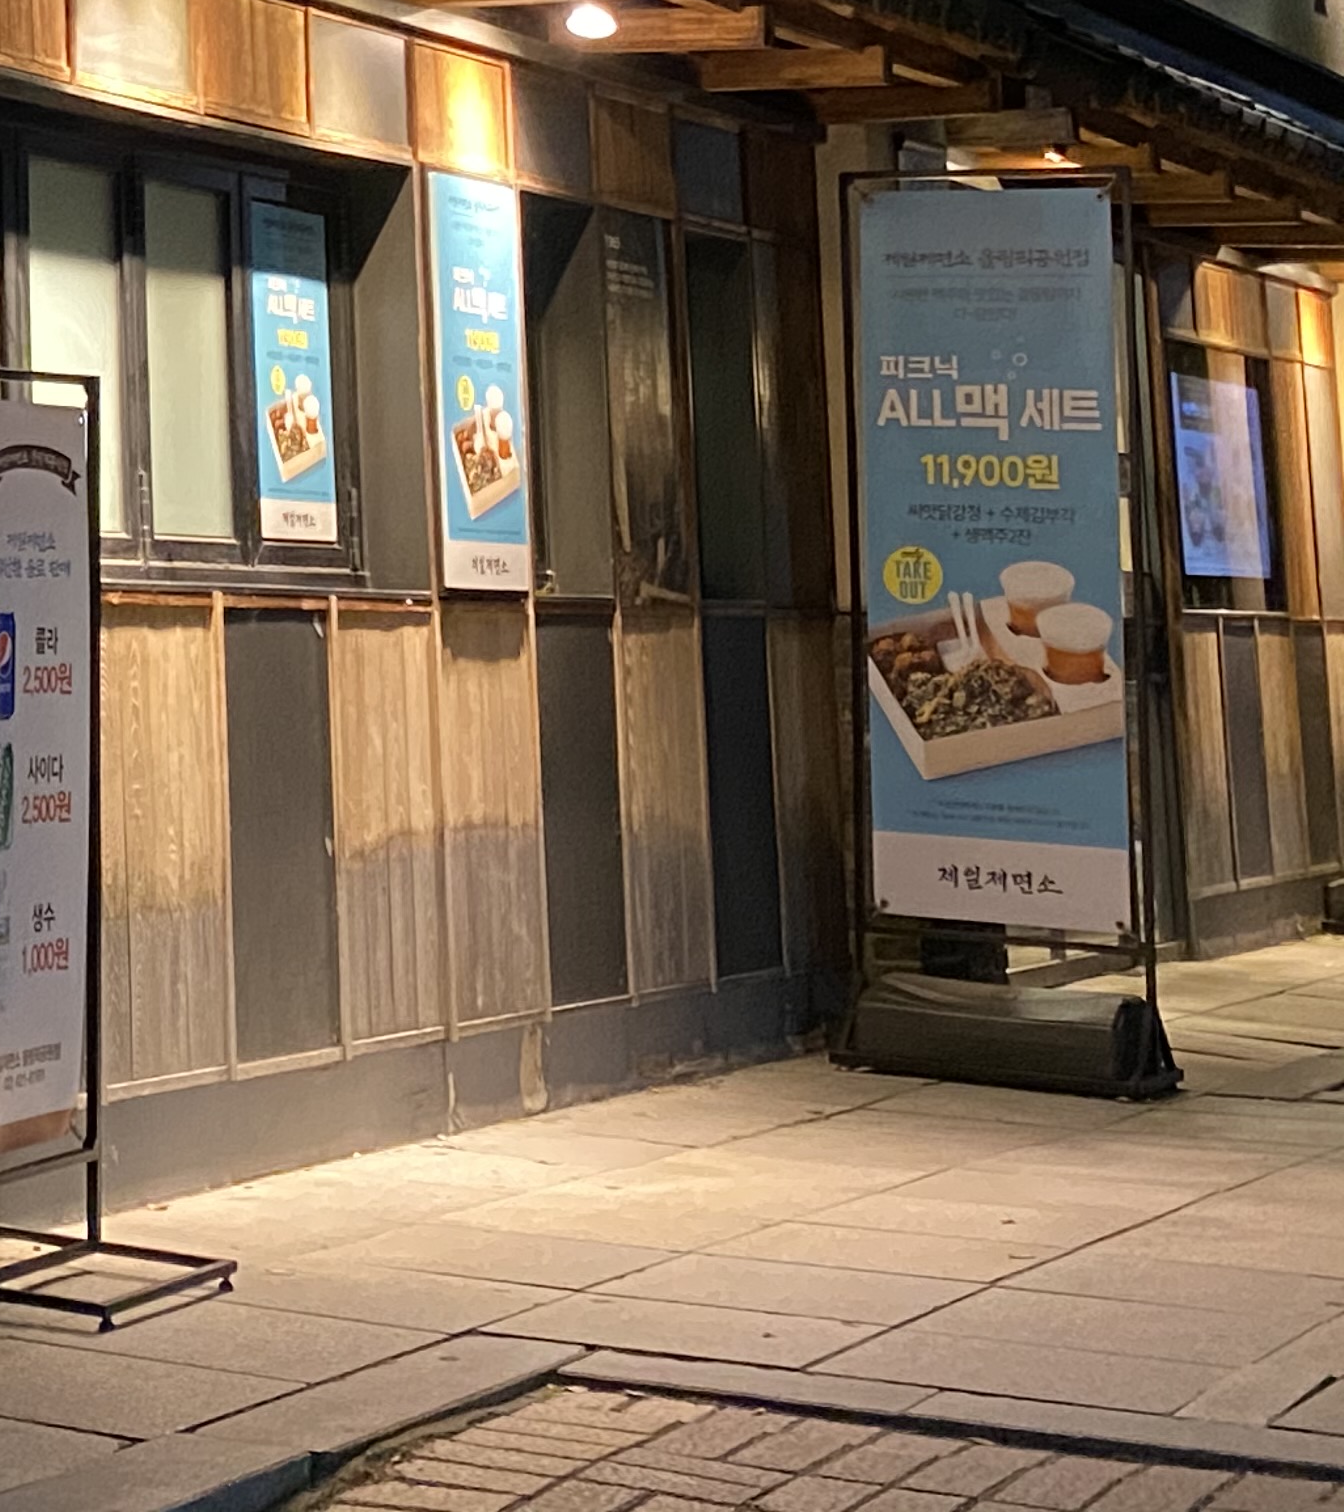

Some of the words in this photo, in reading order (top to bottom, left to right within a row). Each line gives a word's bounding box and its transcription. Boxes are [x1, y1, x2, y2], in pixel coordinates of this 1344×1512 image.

[880, 356, 958, 380] 피크닉
[877, 384, 1009, 441] ALL맥
[1020, 388, 1102, 430] 세트
[920, 454, 1060, 490] 11,900원
[894, 559, 932, 581] TAKE
[899, 581, 928, 599] OUT
[23, 663, 72, 695] 2,500원
[28, 753, 64, 783] 사이다
[21, 791, 72, 824] 2,500원
[937, 864, 1064, 895] 제일제면소
[32, 902, 56, 932] 생수
[22, 938, 69, 974] 1,000원
